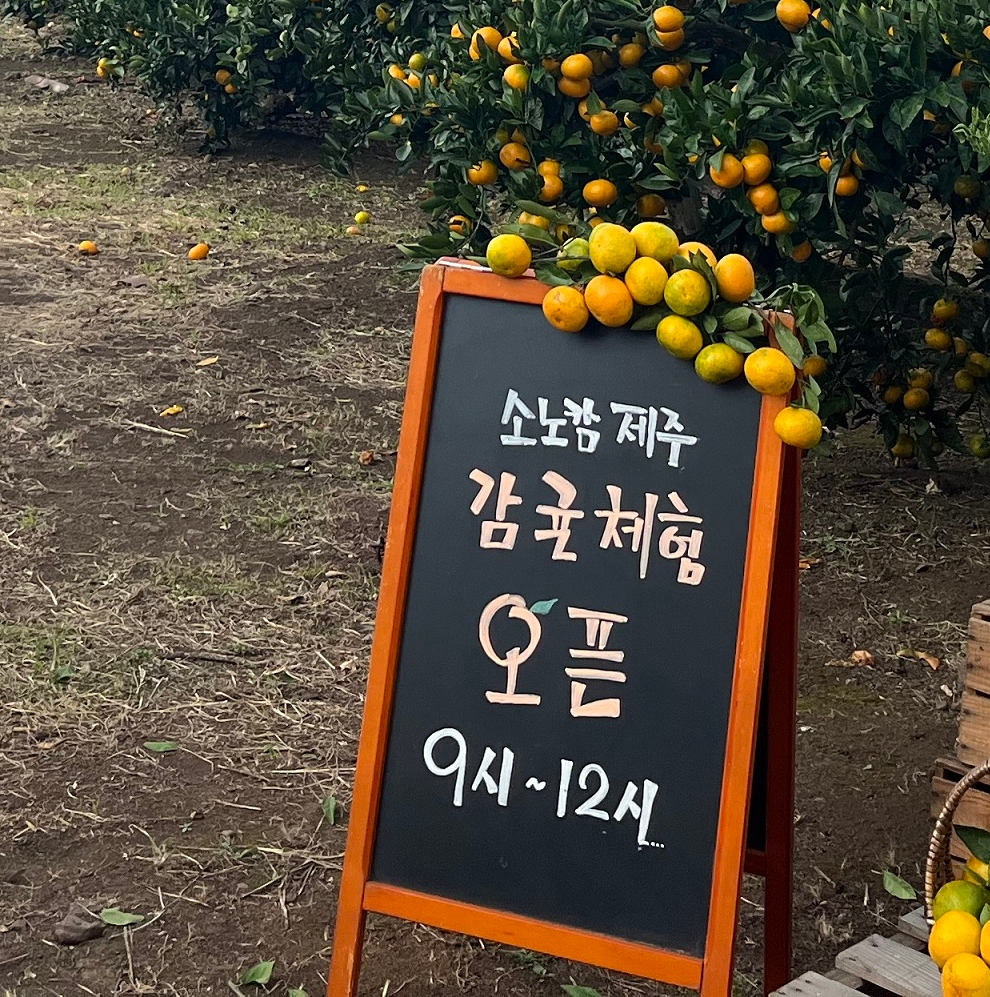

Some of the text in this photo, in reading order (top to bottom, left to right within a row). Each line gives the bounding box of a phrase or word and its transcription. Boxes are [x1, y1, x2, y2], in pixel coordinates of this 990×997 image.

[500, 388, 698, 467] 소노캄 제주
[479, 593, 628, 717] 오픈
